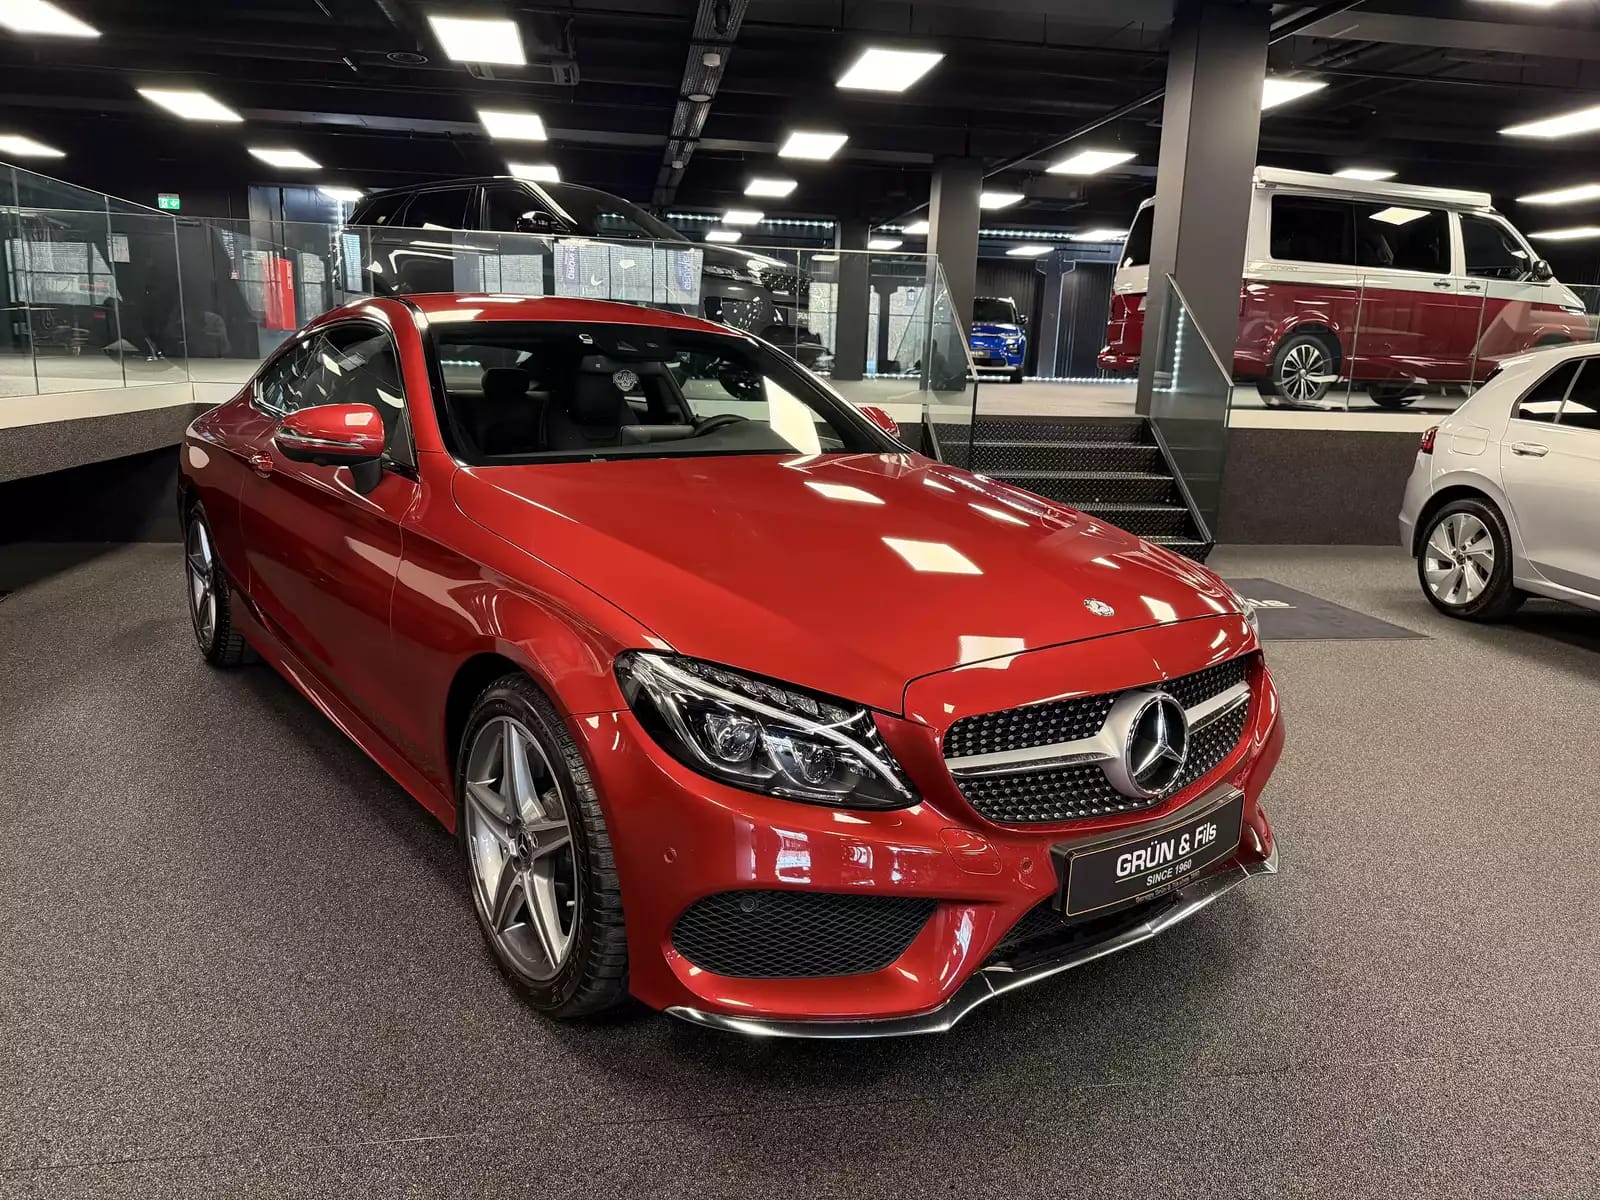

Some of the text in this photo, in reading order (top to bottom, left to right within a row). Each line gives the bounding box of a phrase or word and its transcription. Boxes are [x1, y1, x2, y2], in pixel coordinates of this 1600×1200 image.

[1116, 822, 1217, 877] GRÜN & Fils
[1146, 867, 1173, 886] SINCE
[1175, 859, 1192, 875] 1960
